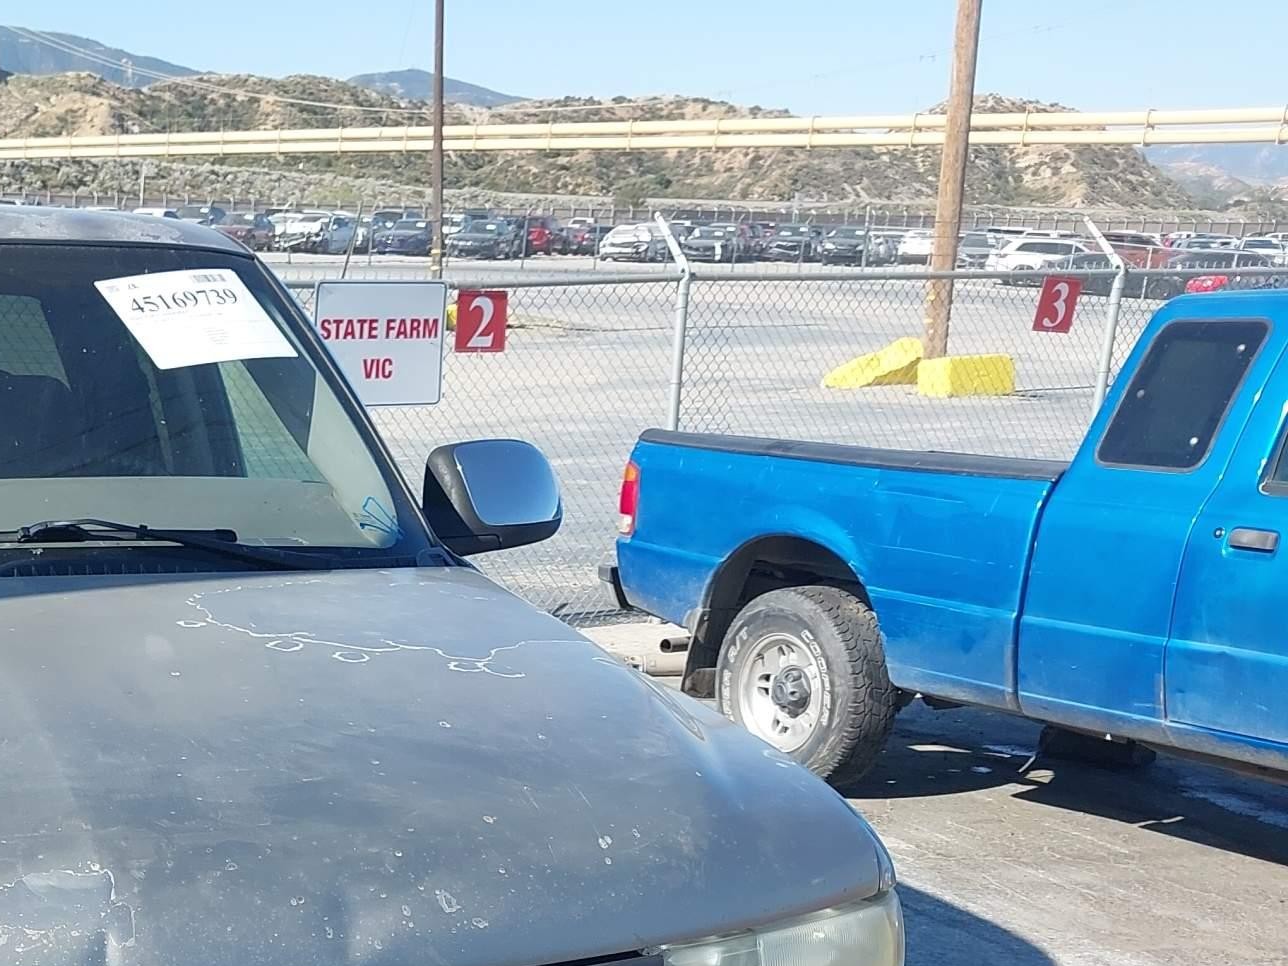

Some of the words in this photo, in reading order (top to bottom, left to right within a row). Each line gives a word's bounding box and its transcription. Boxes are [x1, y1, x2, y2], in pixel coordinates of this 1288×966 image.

[131, 288, 238, 313] 45169739
[1041, 281, 1070, 328] 3
[320, 318, 379, 340] STATE
[385, 318, 439, 340] FARM
[466, 295, 495, 348] 2
[362, 358, 394, 380] VIC
[800, 629, 832, 726] COOPER
